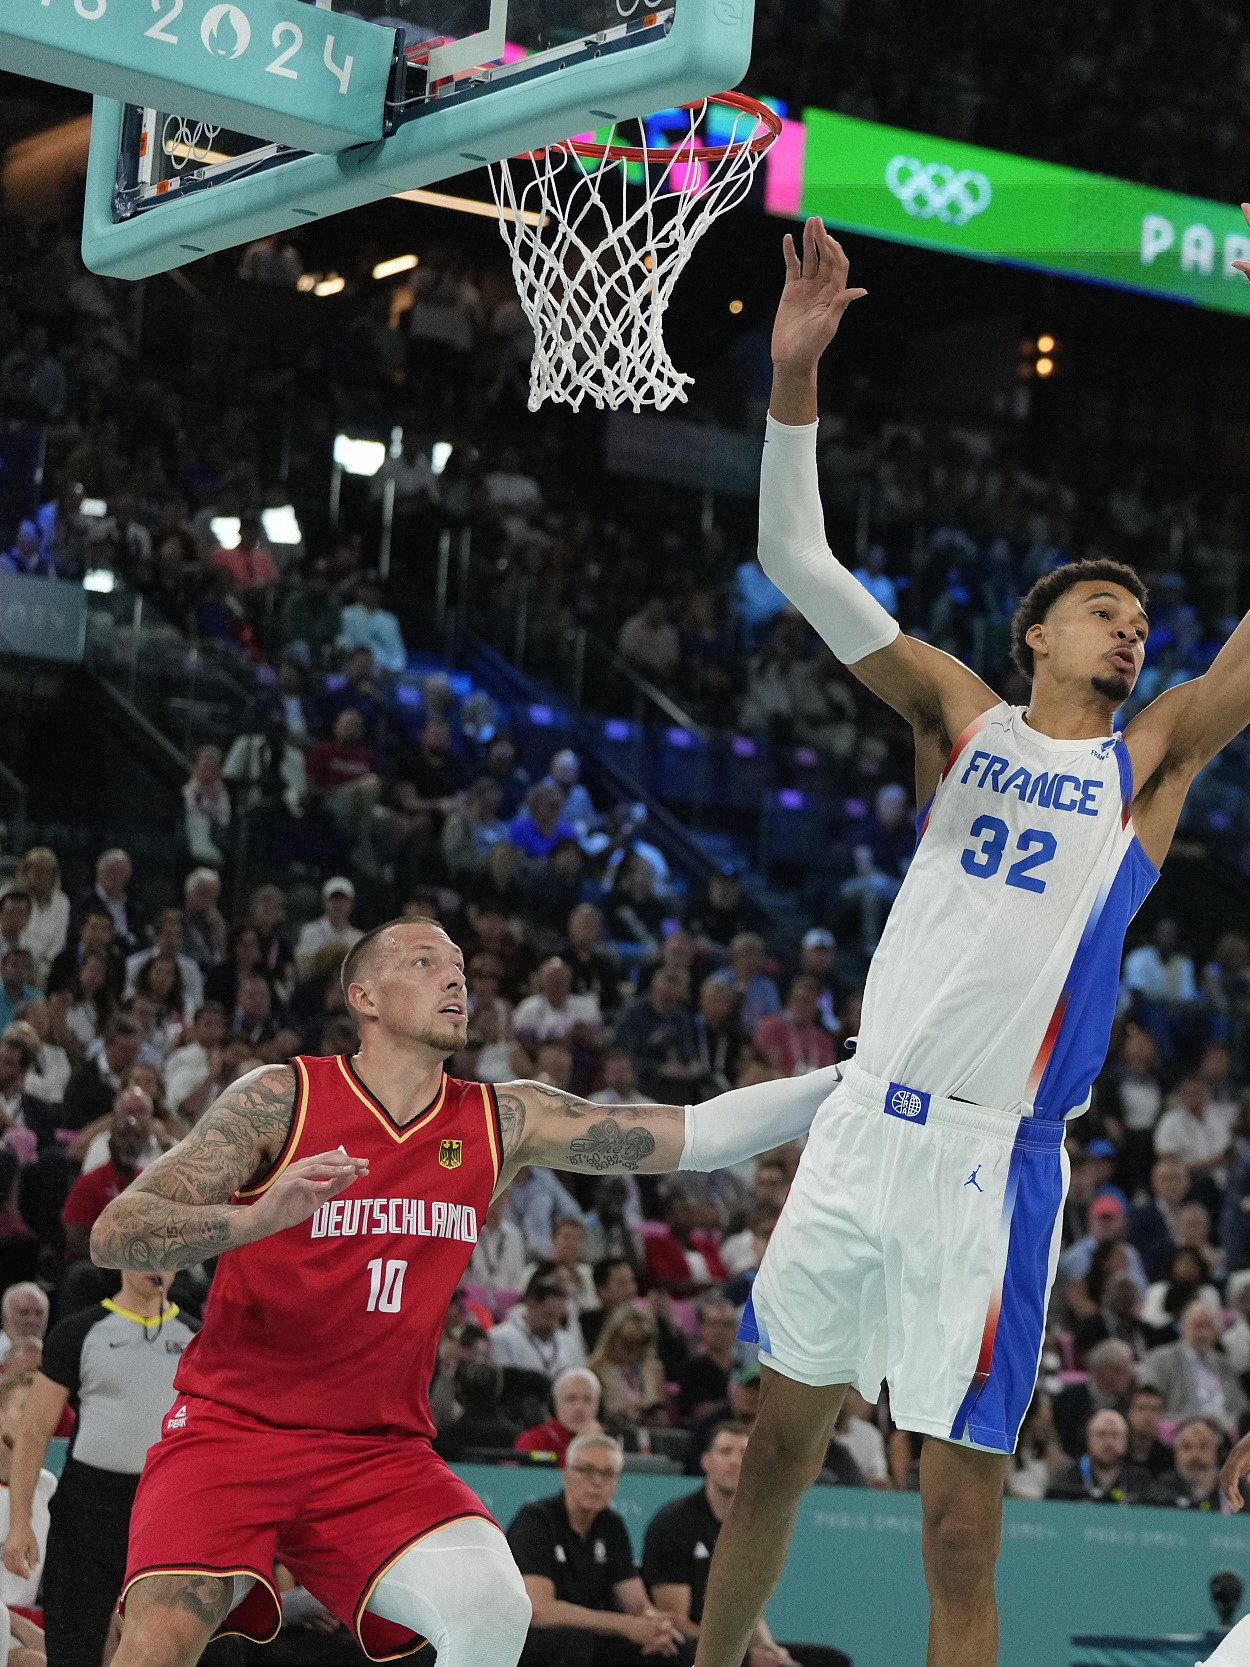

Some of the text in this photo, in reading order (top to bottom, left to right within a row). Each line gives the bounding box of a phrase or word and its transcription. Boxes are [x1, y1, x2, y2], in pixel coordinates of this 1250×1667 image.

[960, 750, 1104, 817] FRANCE
[960, 814, 1058, 895] 32
[311, 1198, 478, 1243] DEUTSCHLAND
[366, 1257, 409, 1313] 10
[167, 1416, 188, 1430] PEAK
